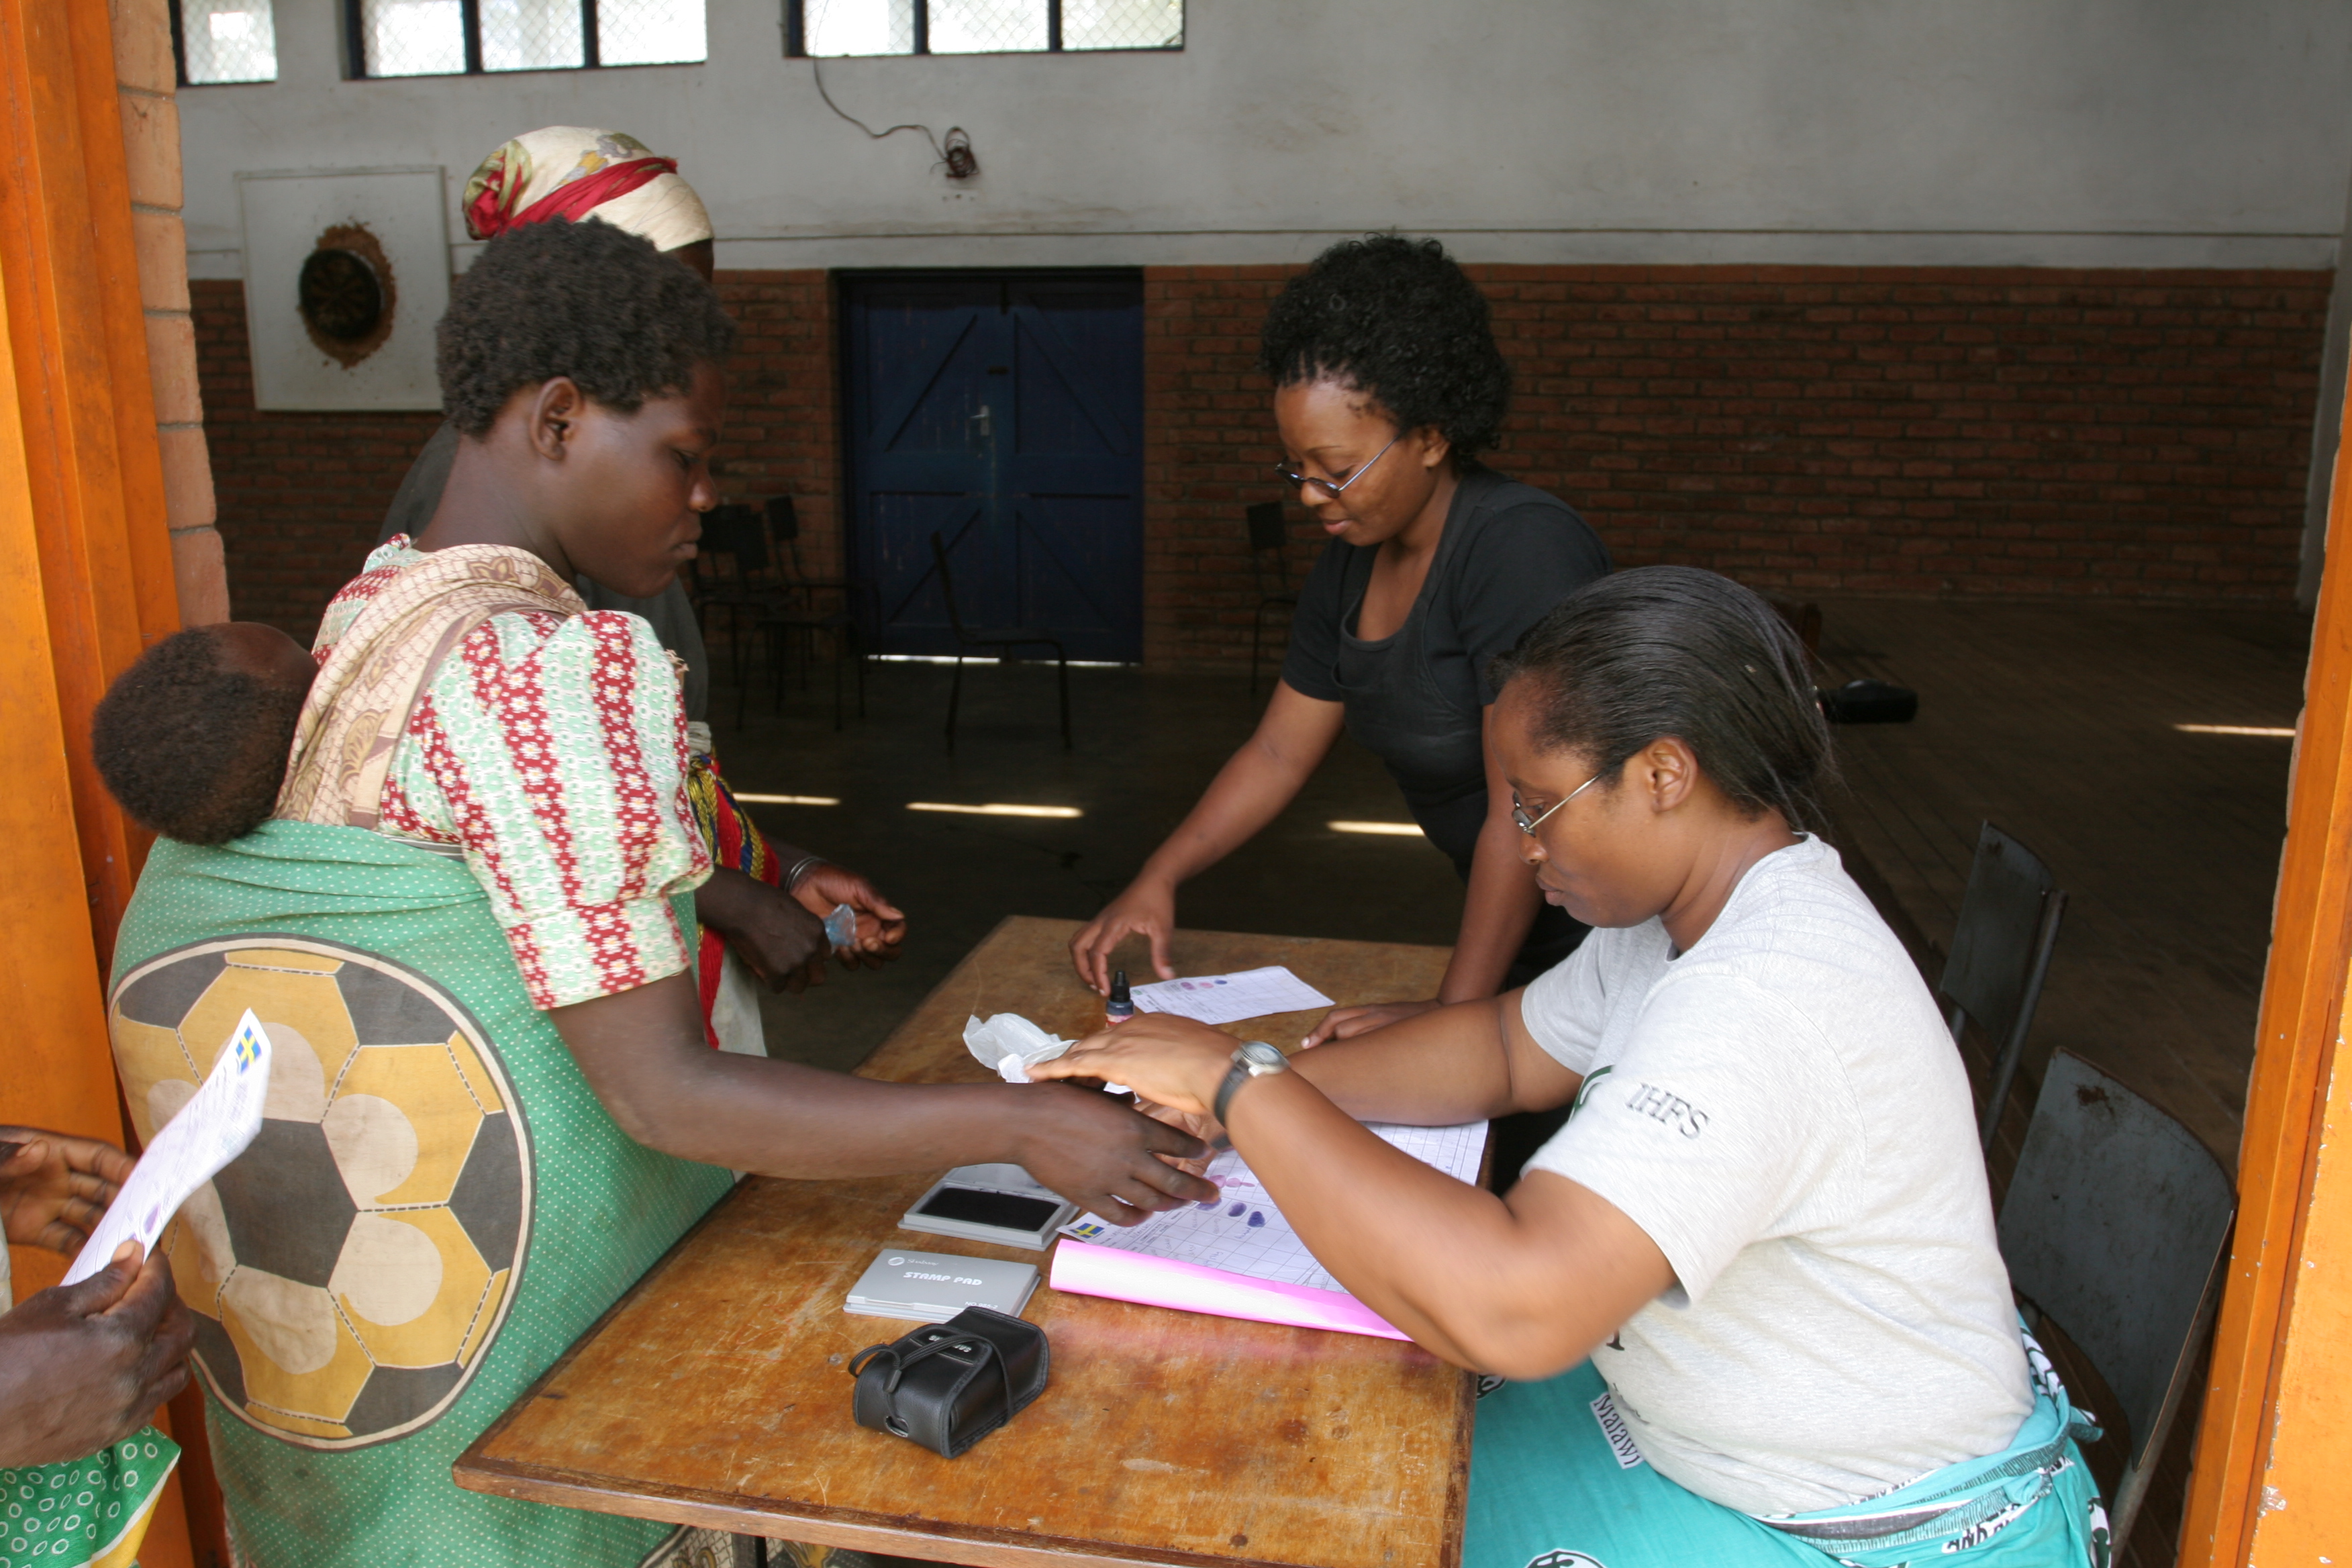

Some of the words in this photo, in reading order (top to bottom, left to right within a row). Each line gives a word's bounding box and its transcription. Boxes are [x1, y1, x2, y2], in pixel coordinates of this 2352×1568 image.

[1624, 1082, 1710, 1140] IHFS
[903, 1271, 951, 1281] STAMP
[953, 1277, 983, 1285] PAD
[1593, 1394, 1640, 1465] Malawi
